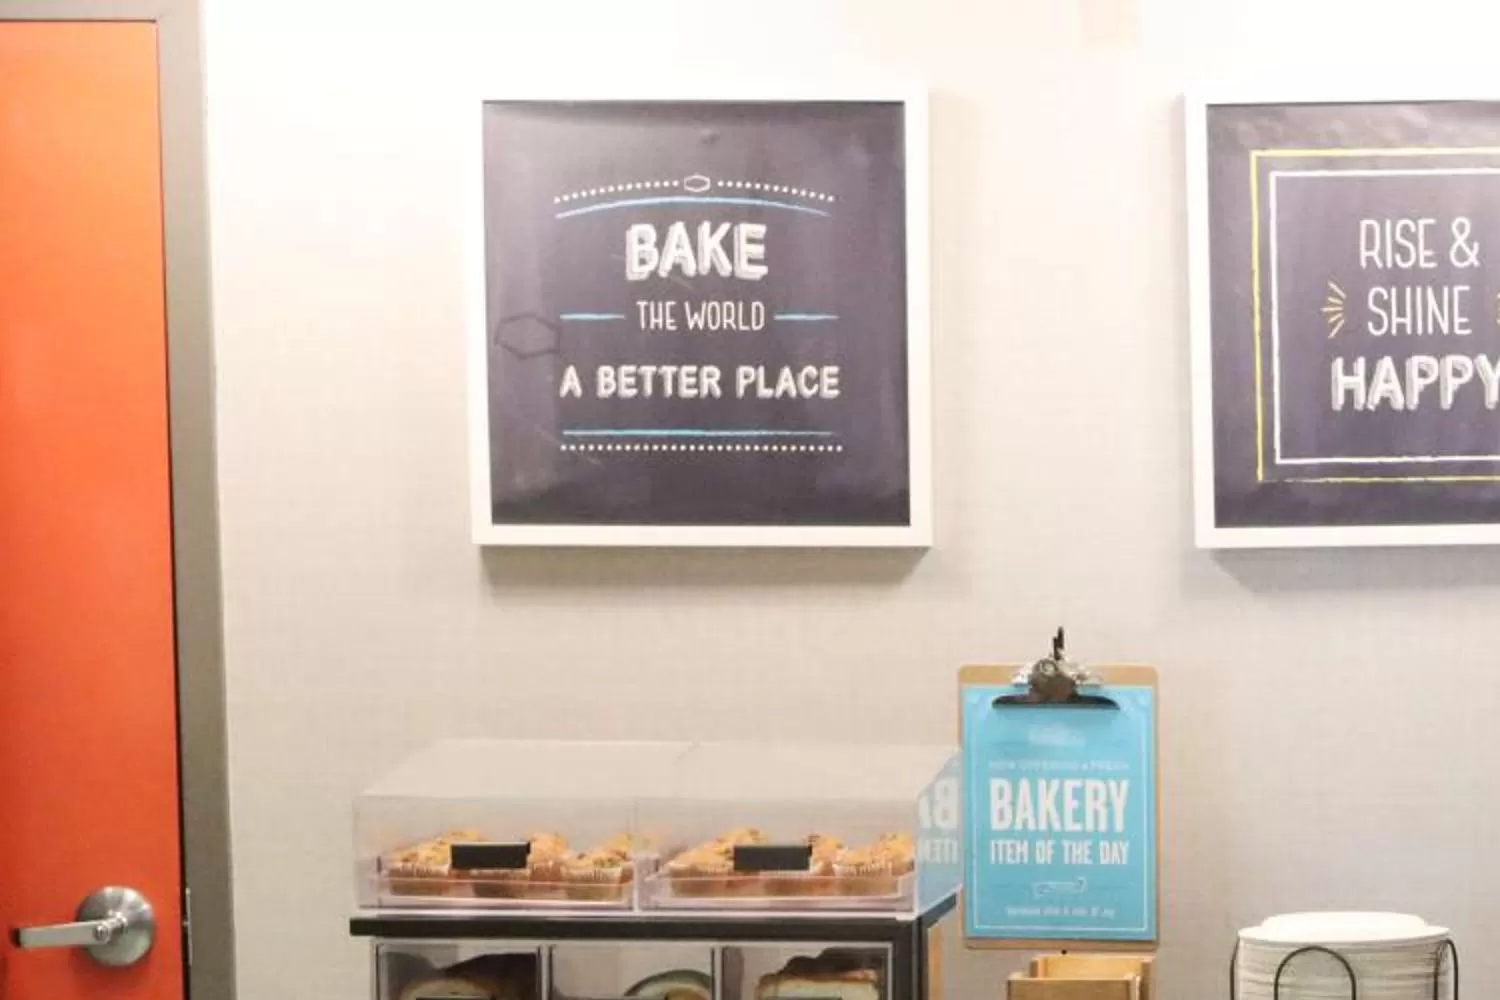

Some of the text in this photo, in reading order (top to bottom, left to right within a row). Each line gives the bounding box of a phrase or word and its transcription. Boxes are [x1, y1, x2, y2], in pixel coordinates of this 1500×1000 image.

[626, 221, 768, 280] BAKE
[1359, 217, 1480, 269] RISE &
[637, 301, 765, 331] THE WORLD
[1367, 285, 1472, 337] SHINE
[559, 365, 841, 399] A BETTER PLACE
[989, 778, 1129, 832] BAKERY
[990, 840, 1129, 864] ITEM OF THE DAY
